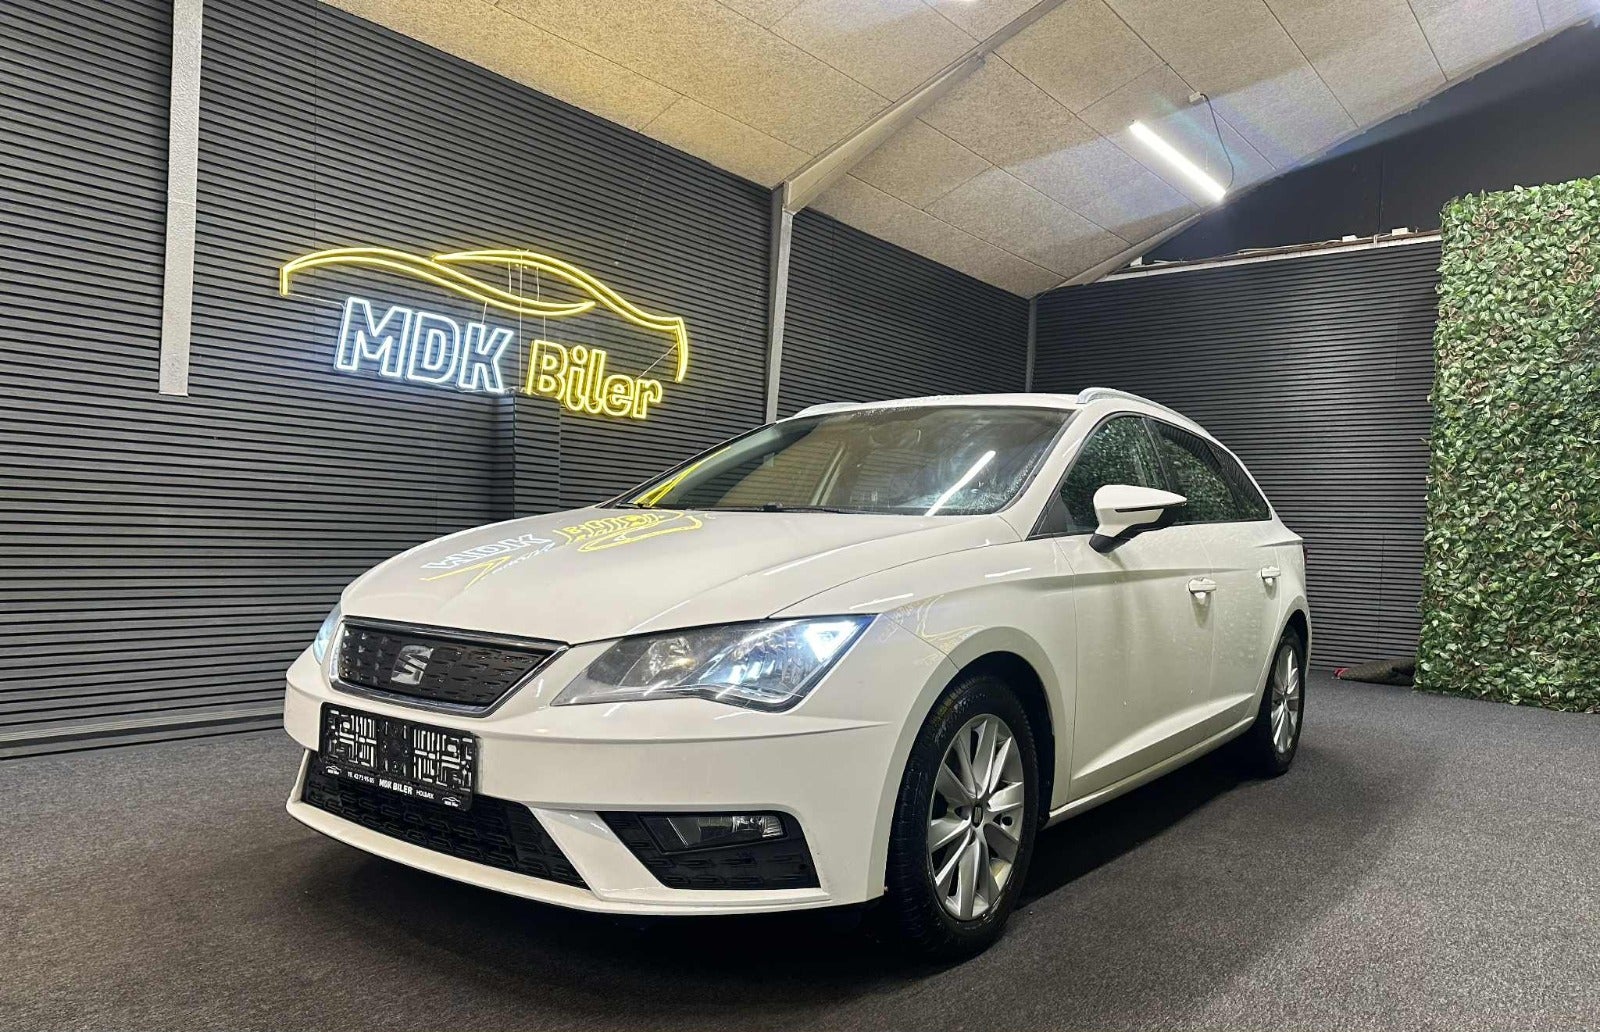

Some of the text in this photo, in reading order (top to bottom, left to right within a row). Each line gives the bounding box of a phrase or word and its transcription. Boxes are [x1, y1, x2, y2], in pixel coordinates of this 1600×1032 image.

[333, 297, 663, 419] MDK Biler
[393, 782, 413, 795] BILER
